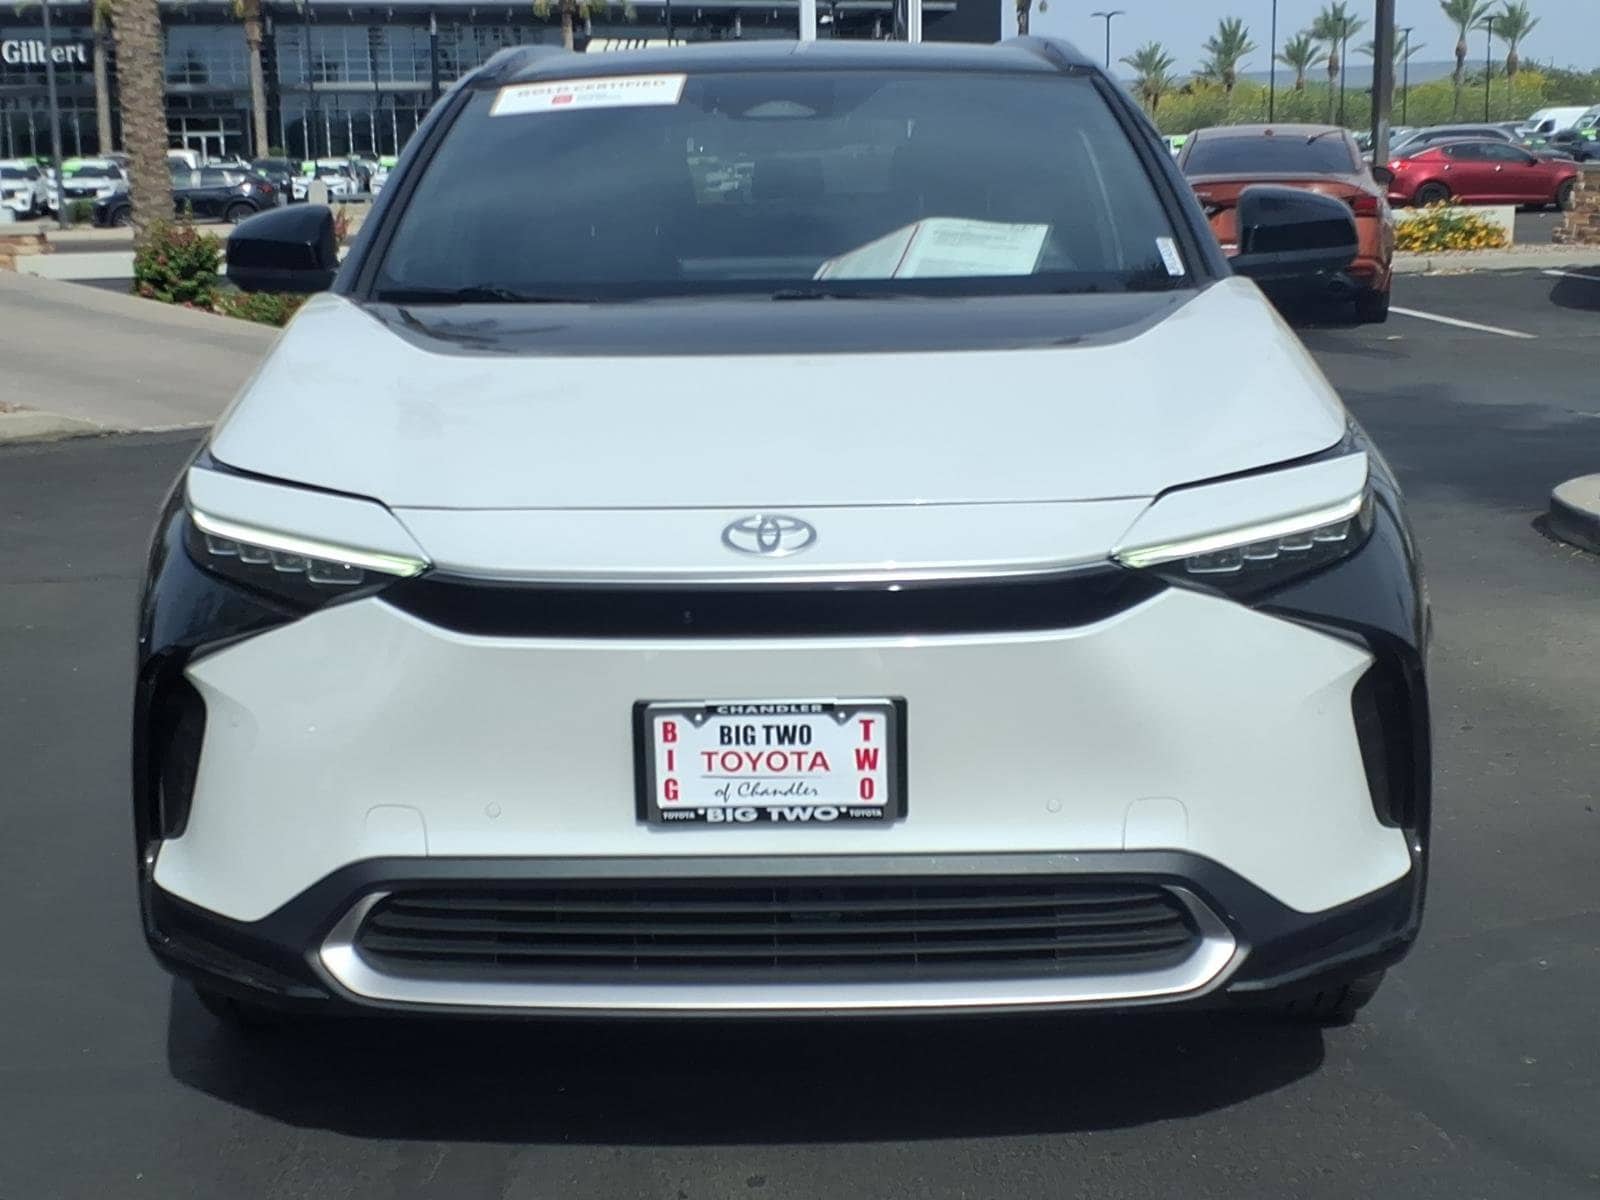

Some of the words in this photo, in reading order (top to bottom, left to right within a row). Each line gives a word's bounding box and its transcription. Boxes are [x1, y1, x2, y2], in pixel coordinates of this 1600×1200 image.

[717, 704, 823, 714] CHANDLER
[719, 724, 757, 746] BIG
[762, 724, 812, 746] TWO
[700, 751, 830, 773] TOYOTA
[714, 782, 731, 804] of
[737, 781, 819, 798] Chandler
[662, 811, 696, 821] TOYOTA
[849, 808, 882, 818] TOYOTA
